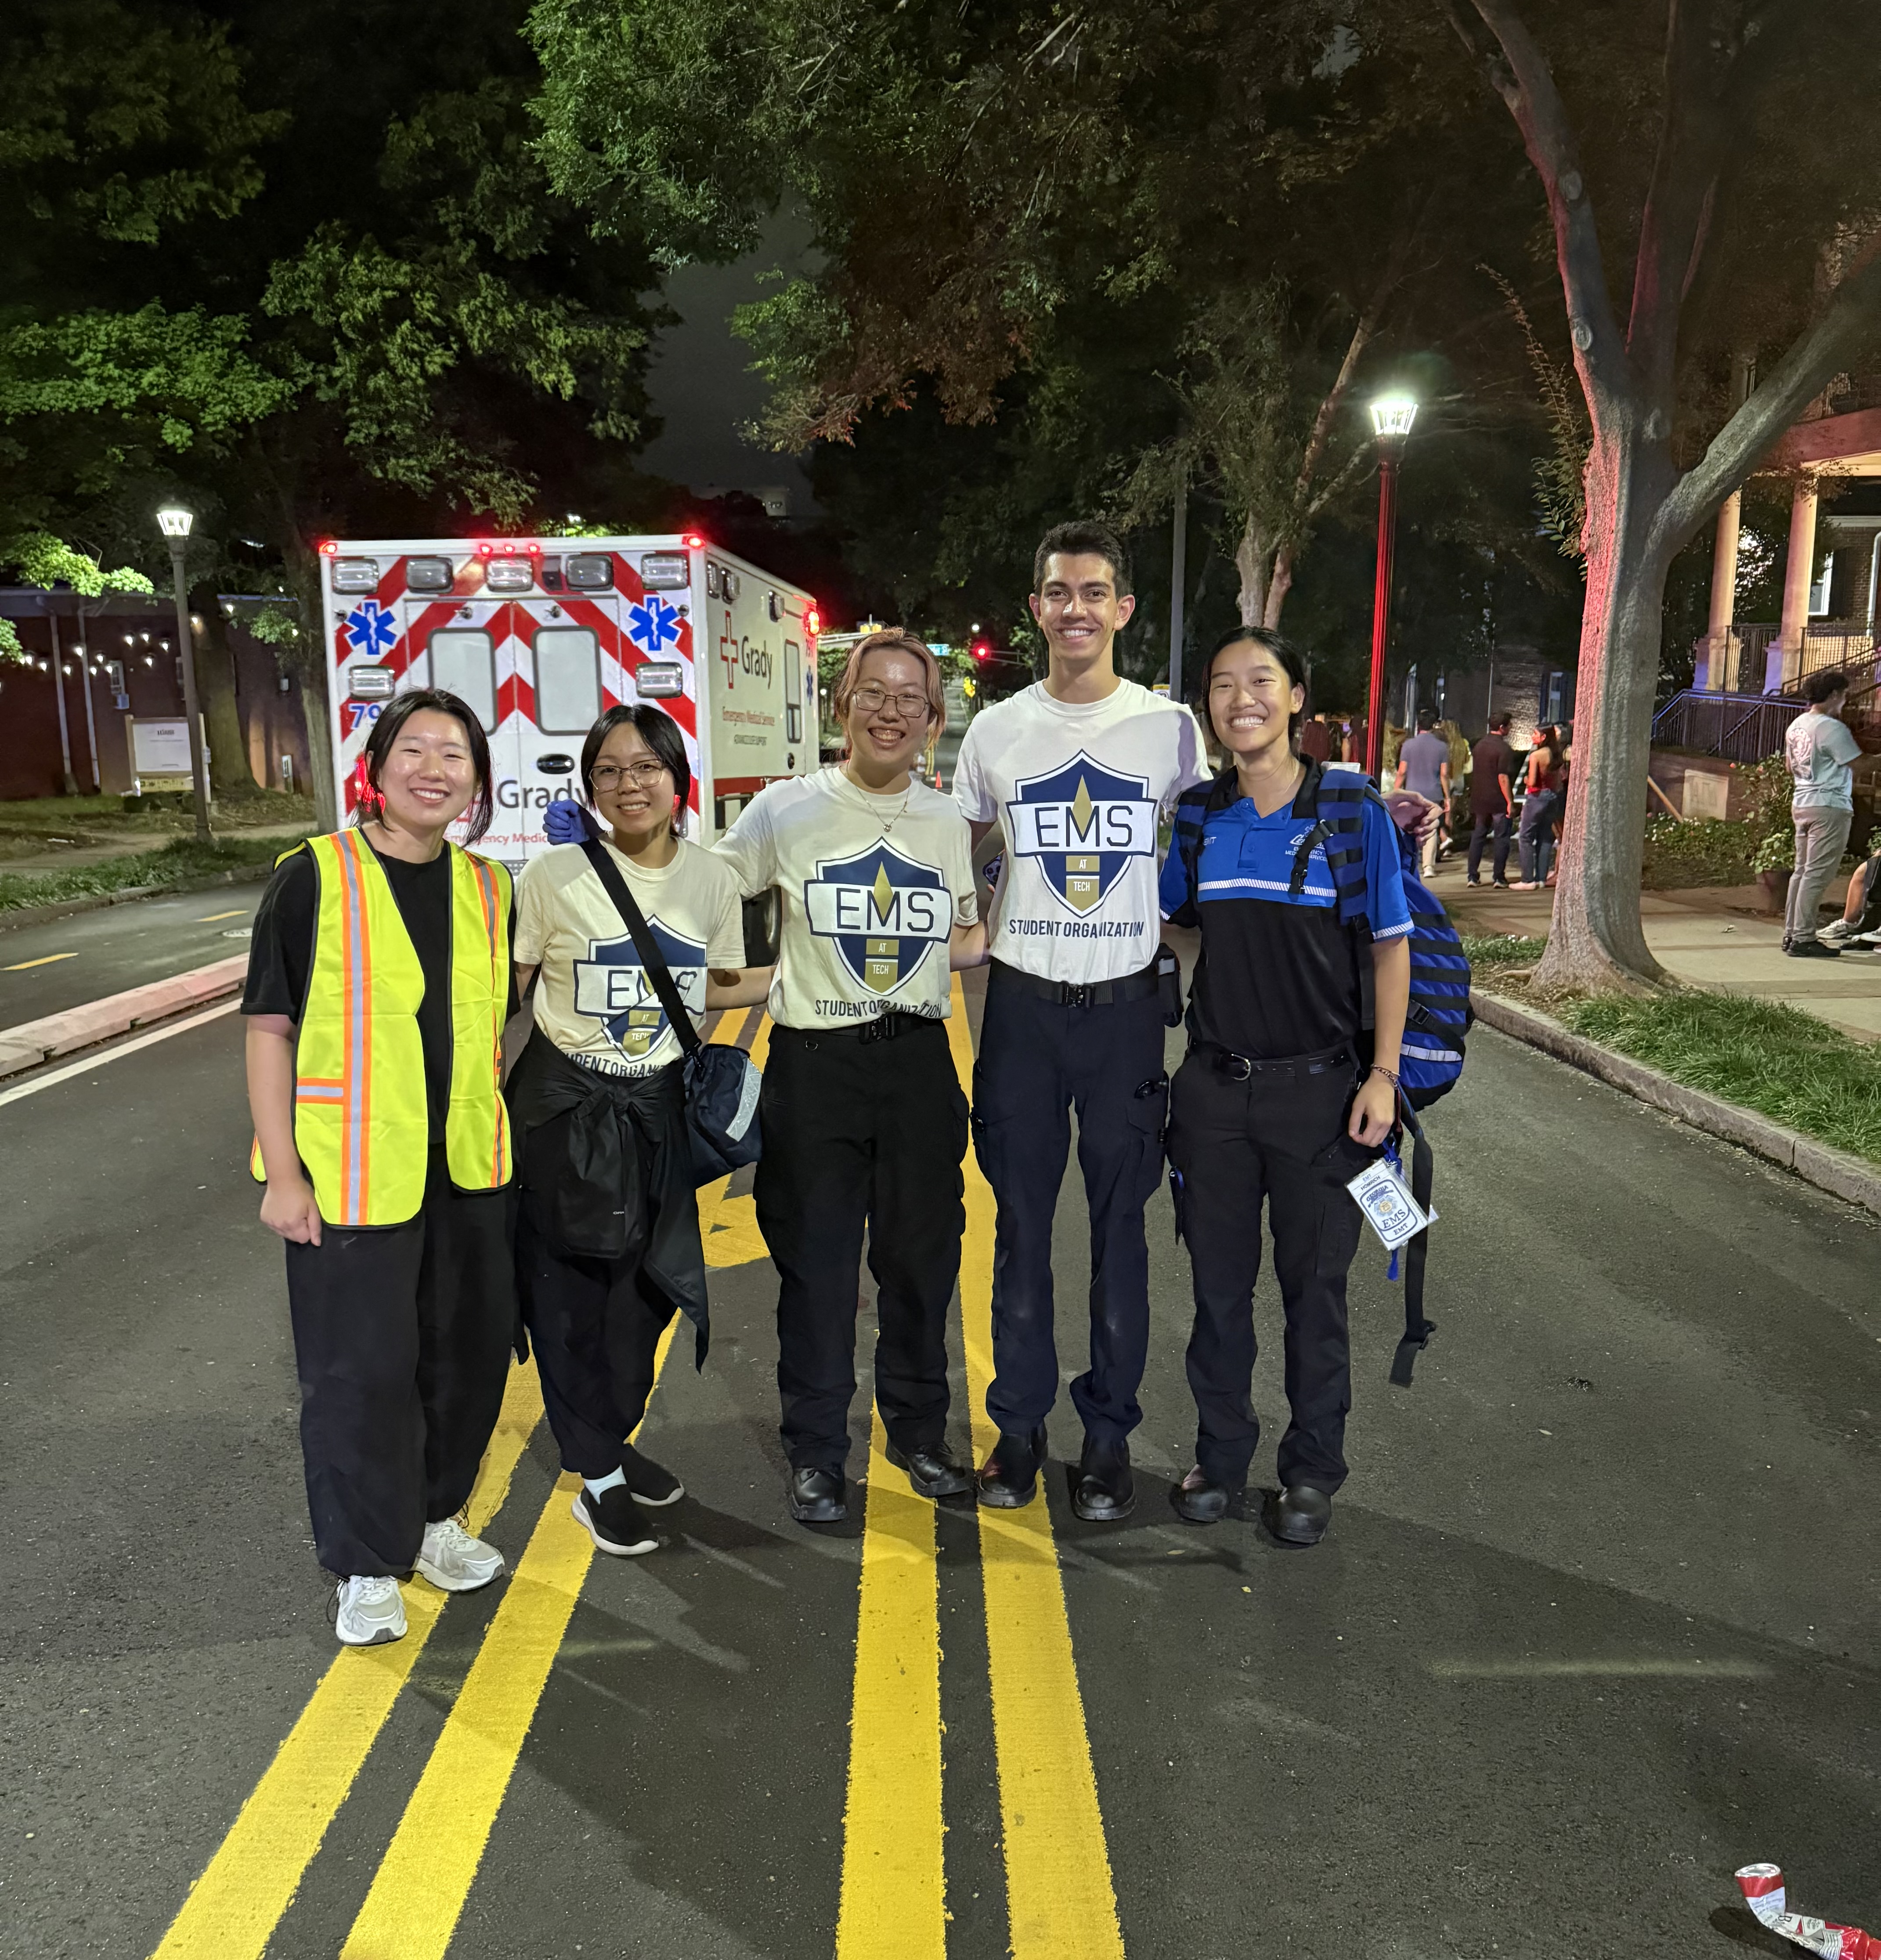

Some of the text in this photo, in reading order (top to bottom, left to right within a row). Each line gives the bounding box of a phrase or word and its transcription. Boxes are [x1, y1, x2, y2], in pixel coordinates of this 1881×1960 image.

[742, 635, 772, 690] Grady
[1035, 805, 1133, 847] EMS
[513, 833, 548, 843] Medic
[1079, 859, 1087, 869] AT
[1073, 881, 1090, 892] TECH
[836, 887, 934, 933] EMS
[1009, 919, 1144, 939] STUDENT ORGANIZATION
[878, 943, 887, 953] AT
[872, 965, 888, 975] TECH
[815, 999, 942, 1018] STUDENT OGANIZTION
[641, 1014, 650, 1023] AT
[566, 1053, 610, 1073] DENT
[1362, 1173, 1371, 1182] EMT
[1382, 1209, 1406, 1229] EMS
[1393, 1223, 1408, 1235] EMT
